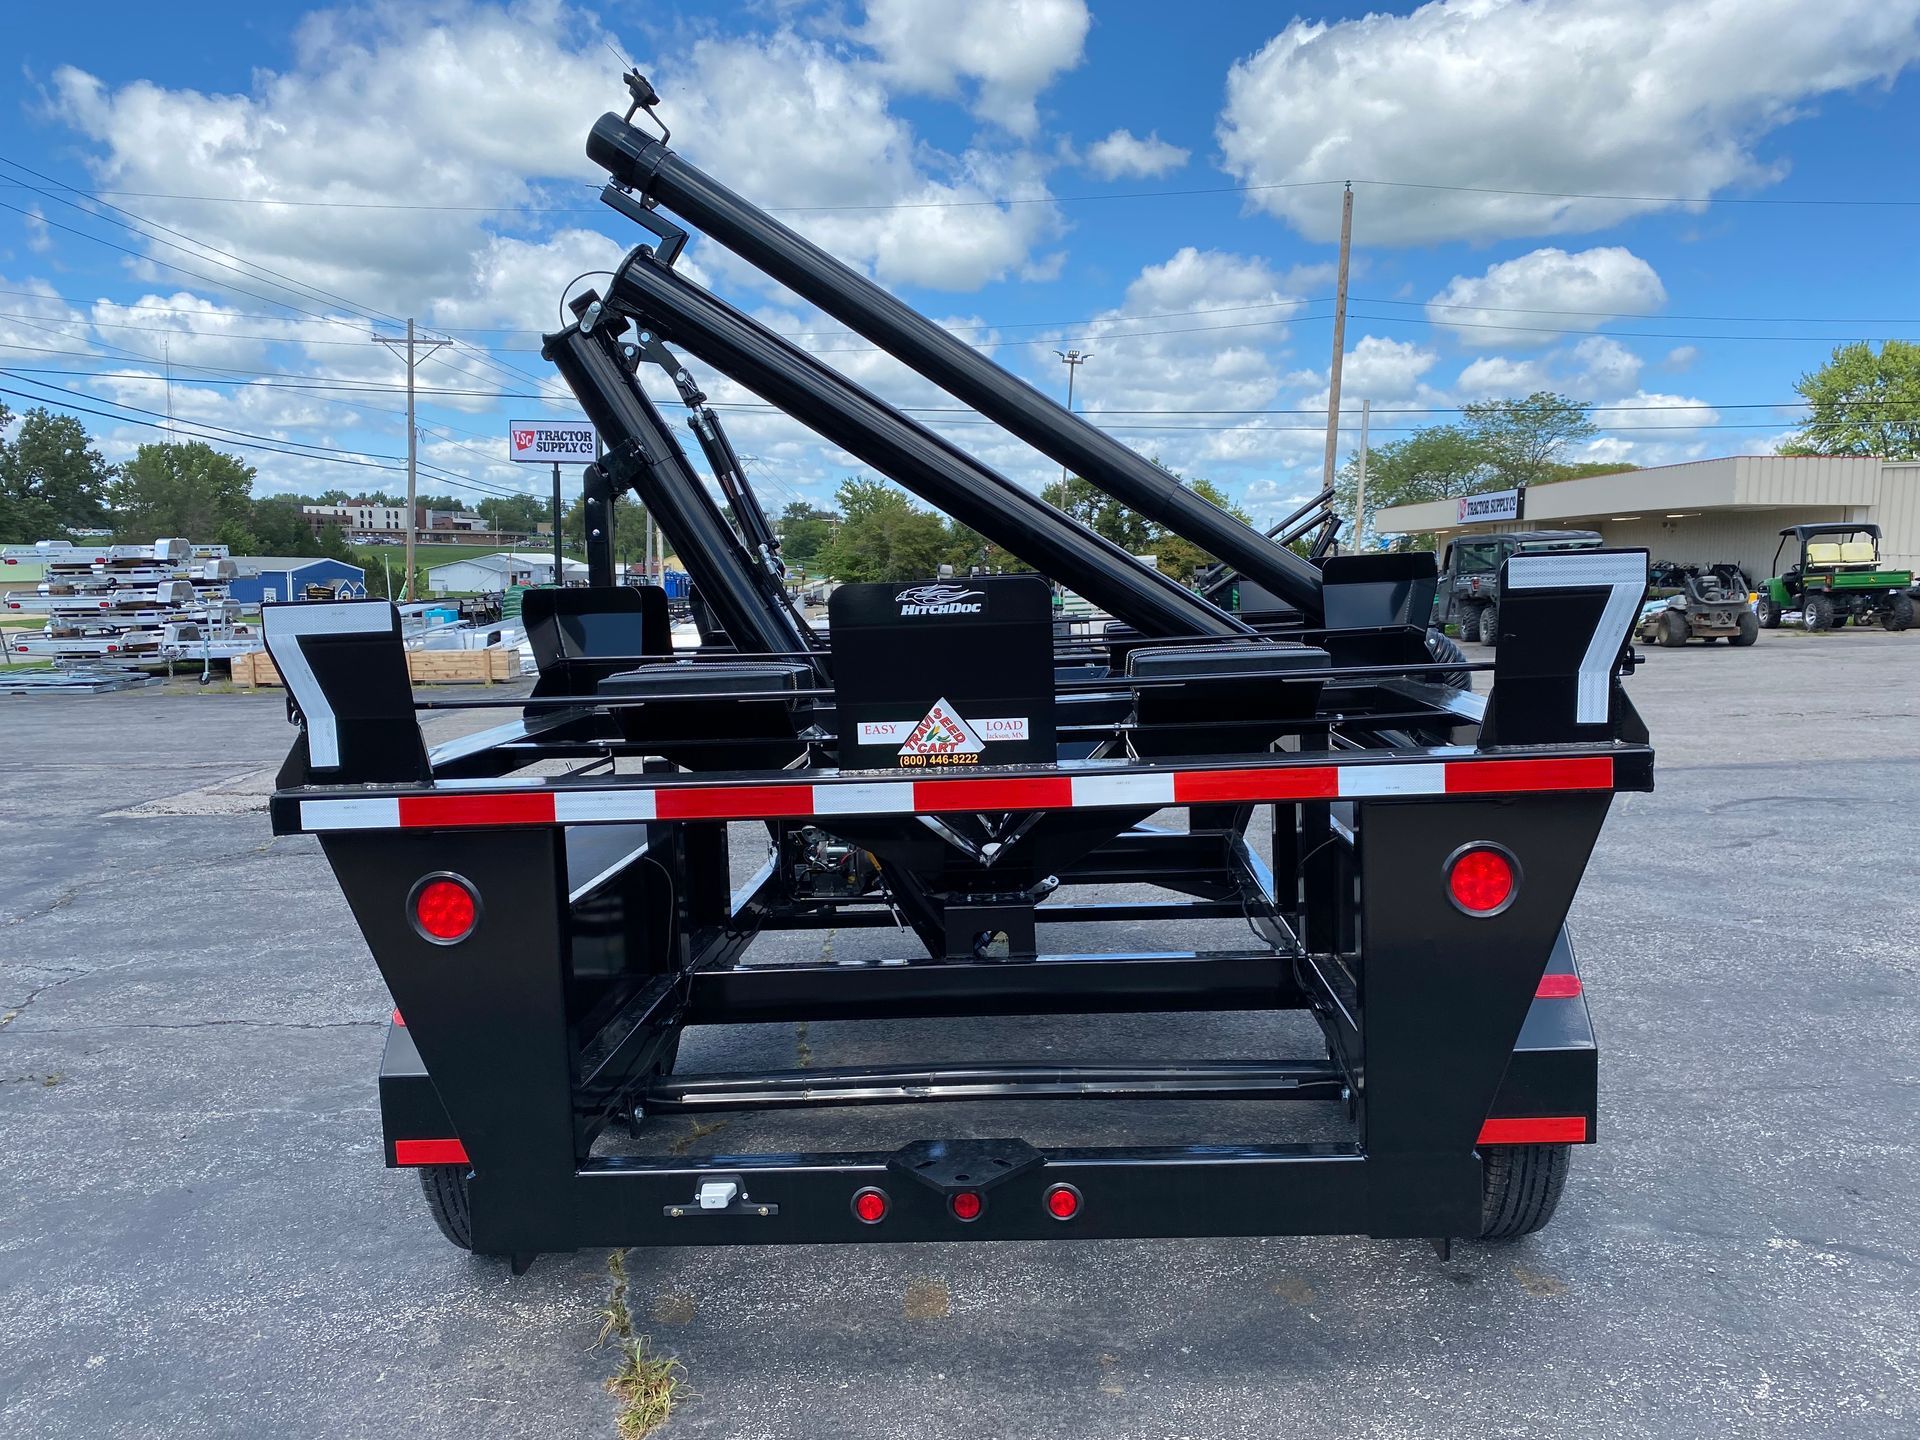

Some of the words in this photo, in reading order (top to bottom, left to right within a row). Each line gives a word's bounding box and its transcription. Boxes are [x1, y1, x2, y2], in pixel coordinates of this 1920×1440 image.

[514, 431, 532, 447] TSC
[536, 430, 592, 442] TRACTOR
[536, 442, 578, 453] SUPPLY
[1467, 500, 1489, 516] TRACTOR
[1490, 497, 1509, 513] SUPPLY
[864, 724, 897, 735] EASY
[986, 720, 1024, 731] LOAD
[986, 732, 1011, 740] Jackson,
[916, 742, 959, 754] CART
[899, 755, 927, 767] (800)
[929, 754, 979, 764] 446-8222
